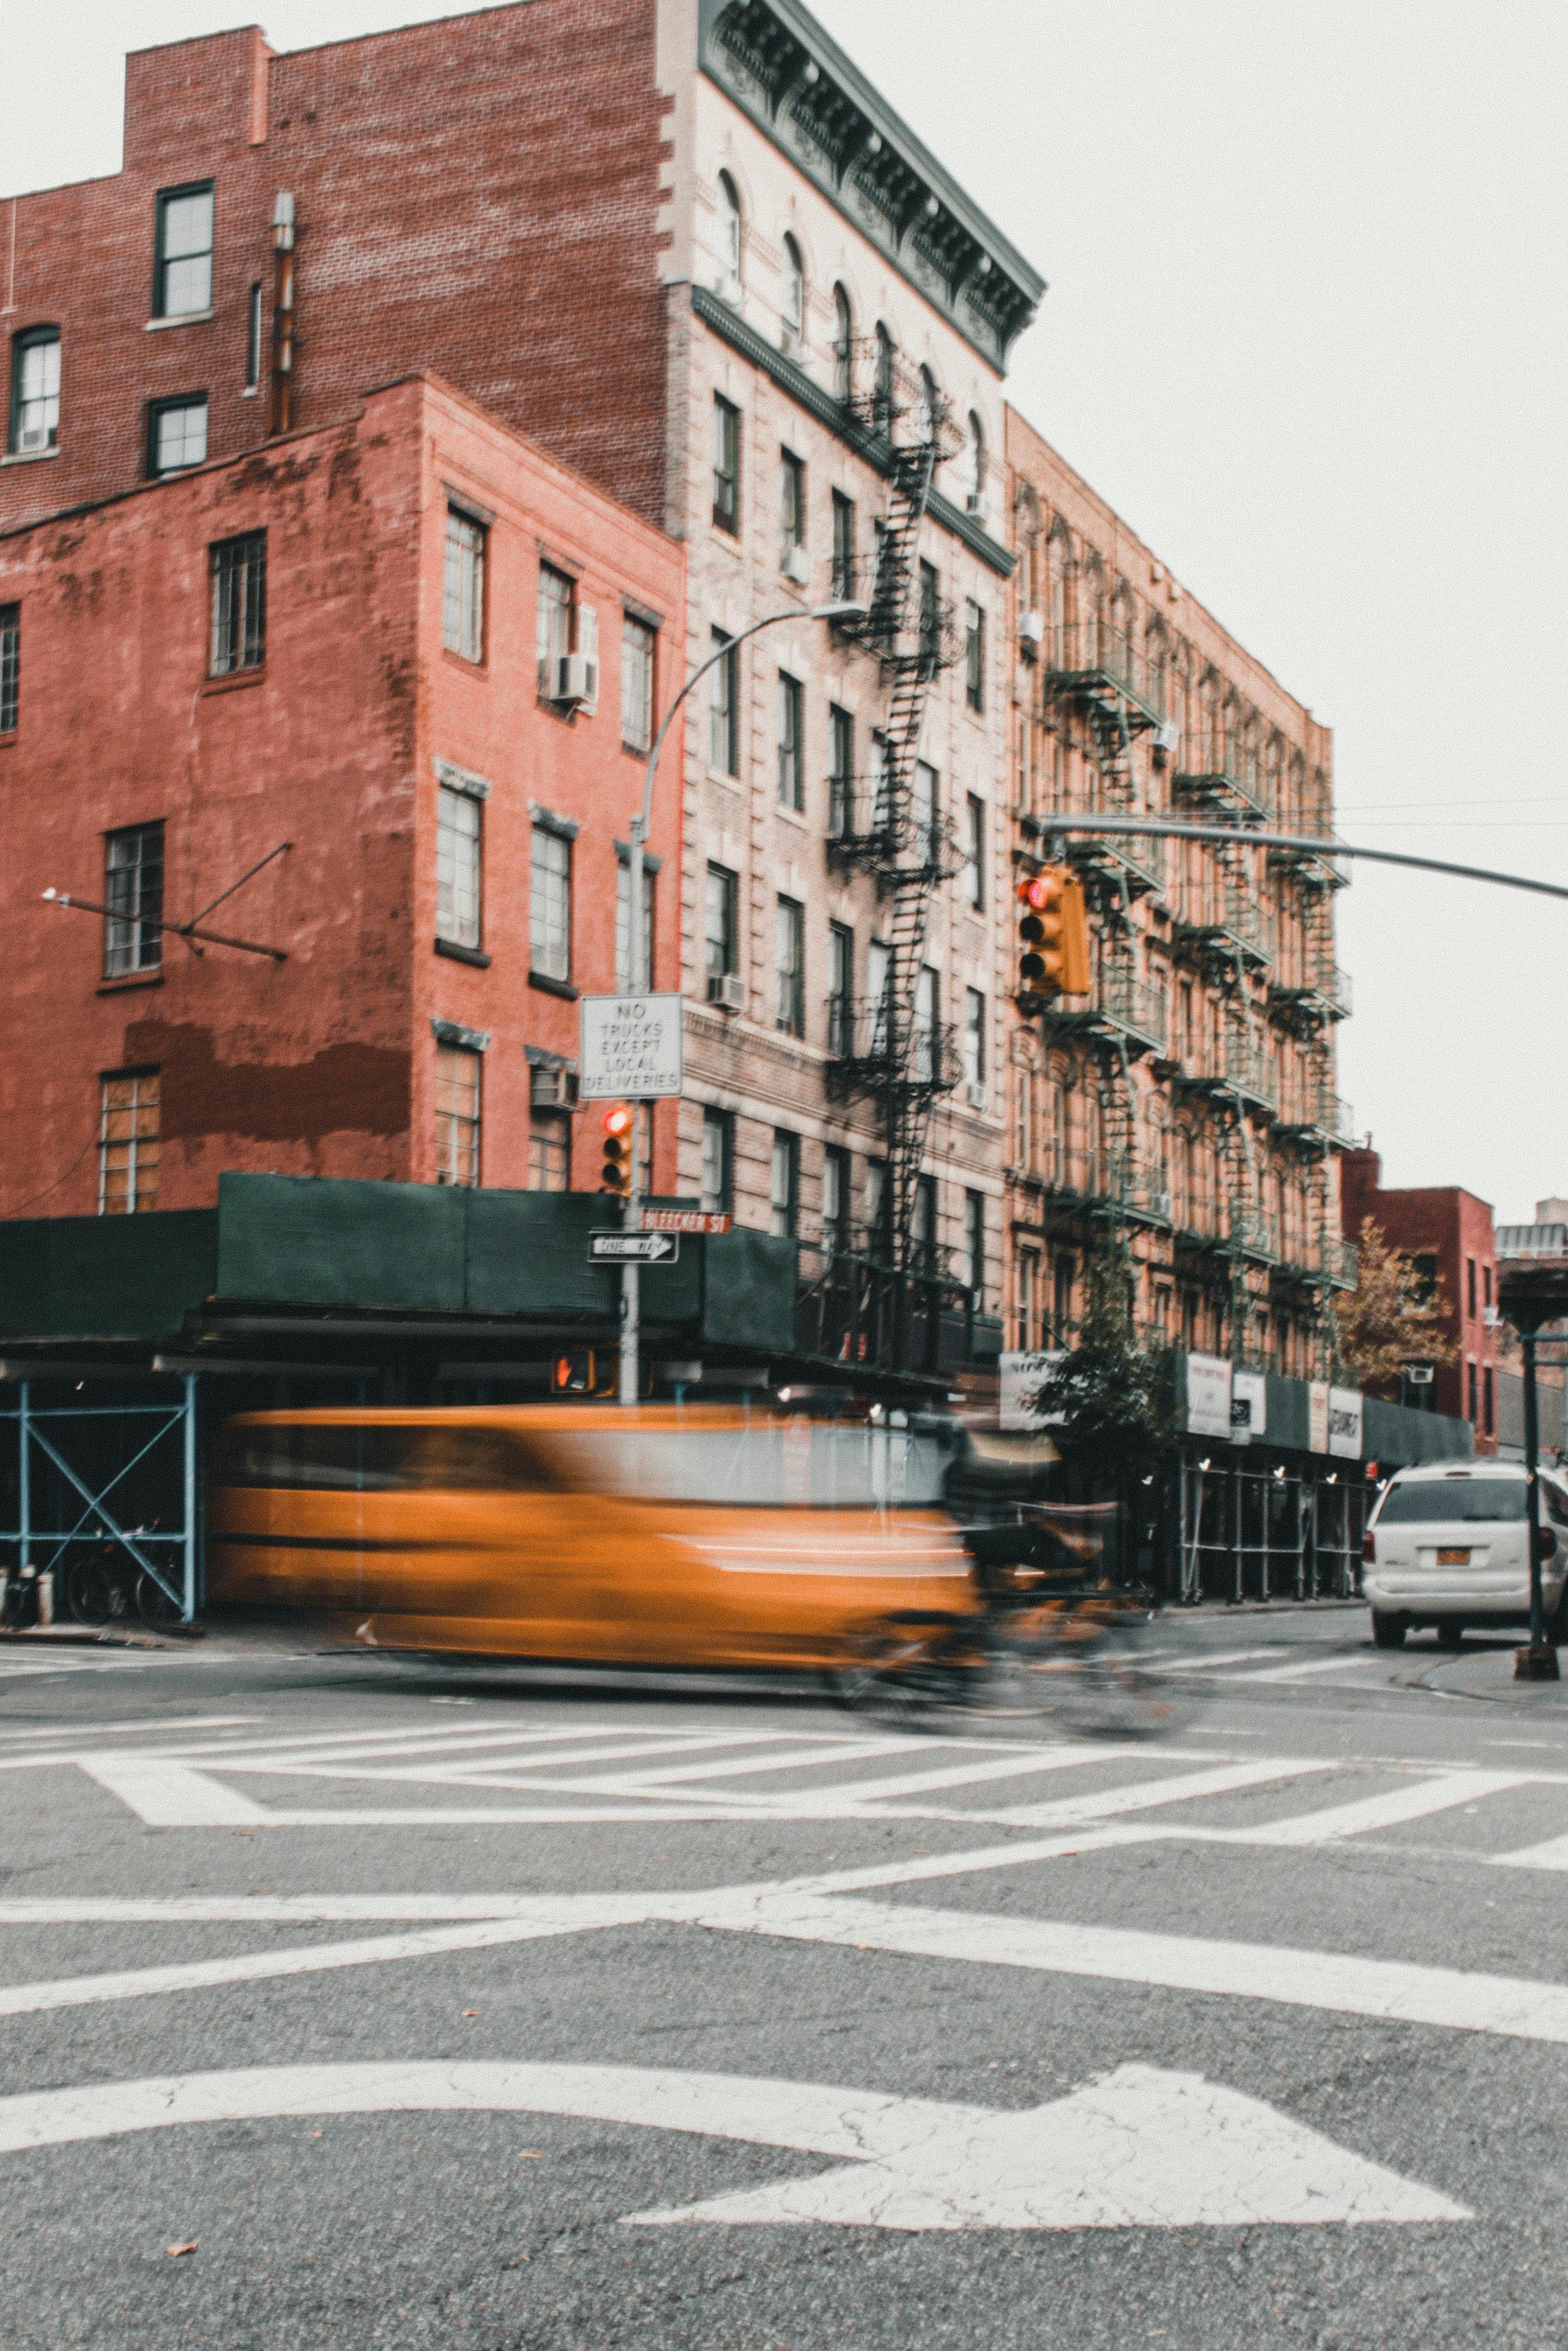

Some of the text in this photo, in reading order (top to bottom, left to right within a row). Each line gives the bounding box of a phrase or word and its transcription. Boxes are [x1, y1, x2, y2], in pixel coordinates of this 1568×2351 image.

[618, 1003, 646, 1019] NO
[601, 1022, 663, 1038] TRUCKS
[602, 1040, 660, 1055] EXCEPT
[606, 1057, 656, 1072] LOCAL
[585, 1074, 678, 1090] DELIVERIES
[645, 1212, 725, 1232] BLEECKER ST
[601, 1241, 663, 1253] ONE WAY
